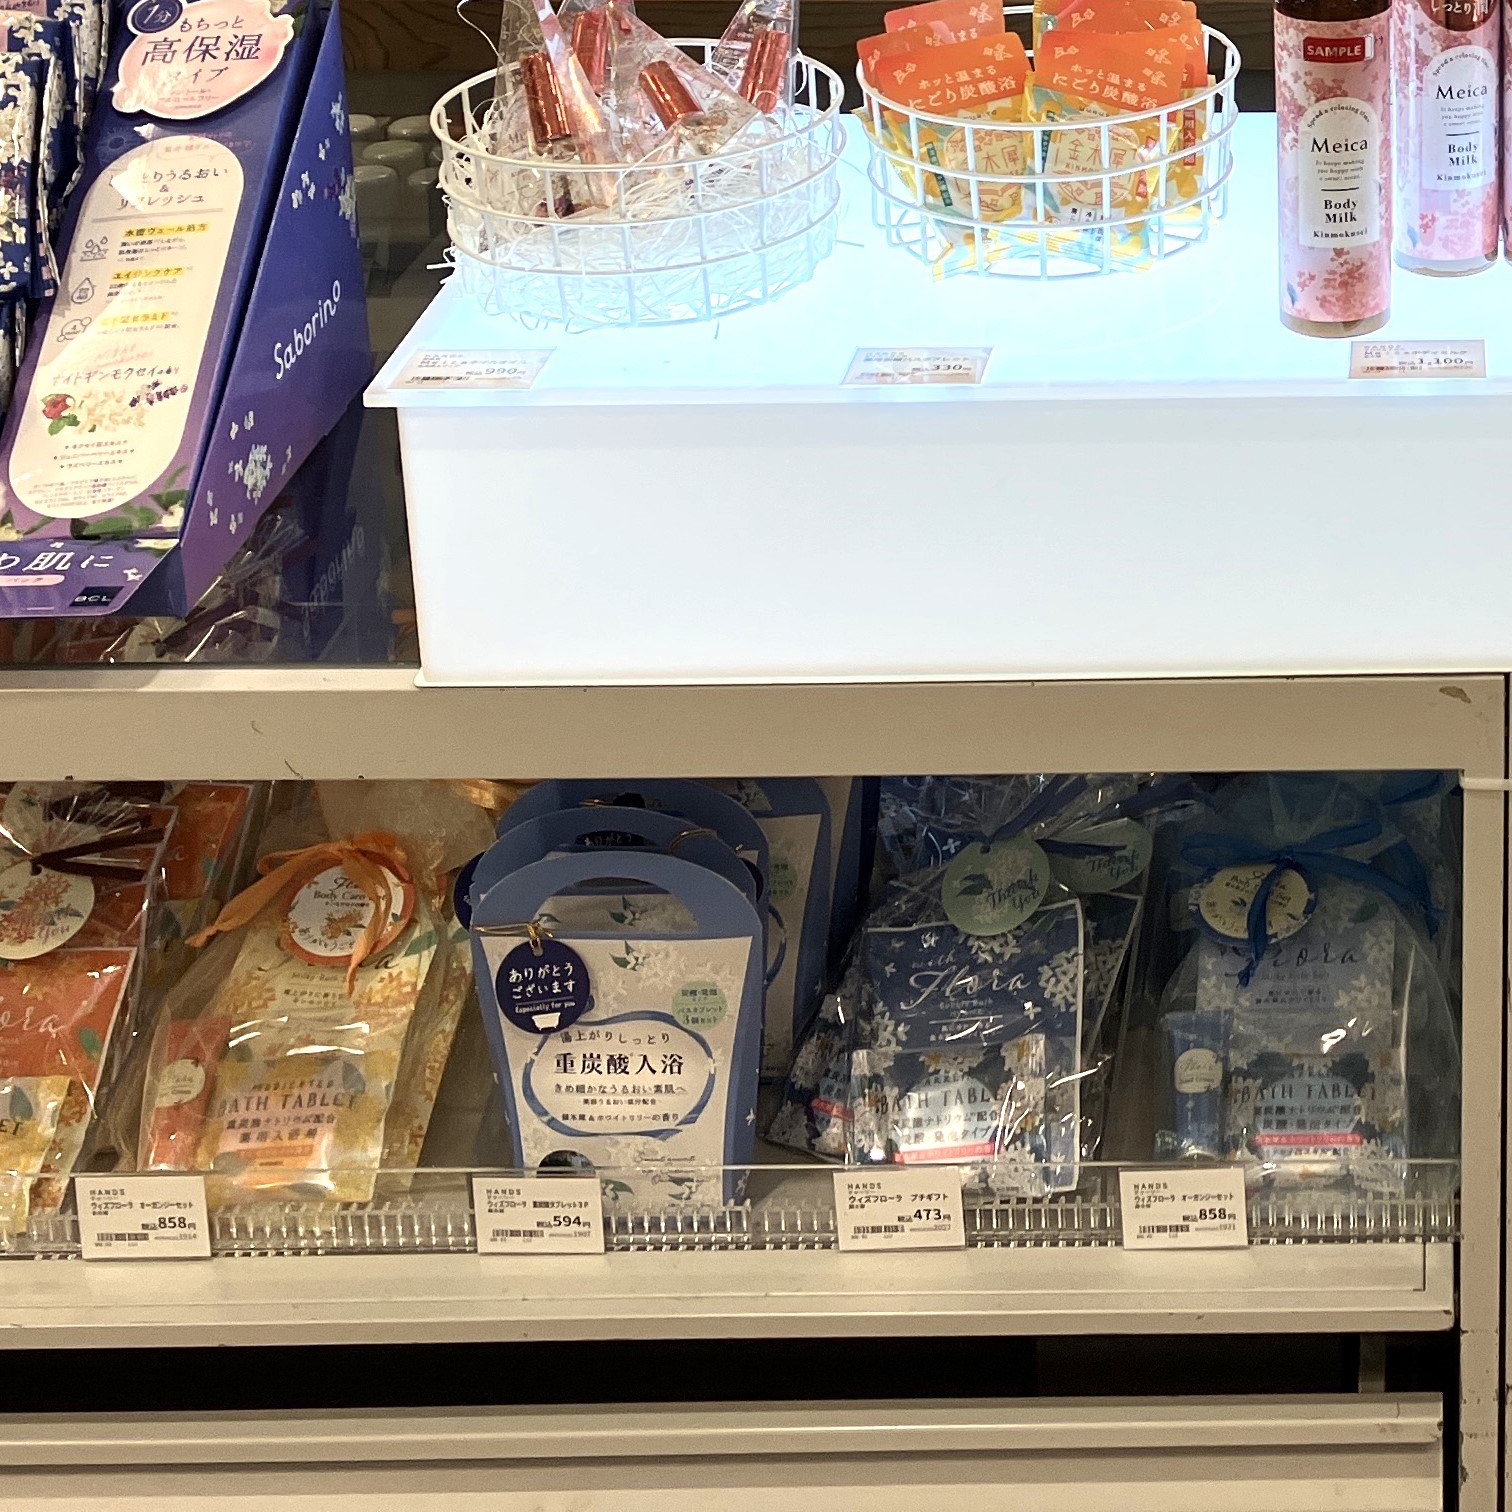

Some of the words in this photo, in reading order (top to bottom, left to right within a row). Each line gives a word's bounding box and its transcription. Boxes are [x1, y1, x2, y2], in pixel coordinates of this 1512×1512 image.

[143, 1, 172, 25] 1分
[180, 17, 244, 33] もちっと
[142, 34, 263, 64] 高保湿
[1306, 45, 1361, 56] SAMPLE
[918, 65, 997, 90] ホッと温まる
[1070, 63, 1147, 92] ホッと温まる
[908, 76, 1019, 111] にごり炭酸浴
[1052, 72, 1158, 109] にごり炭酸浴
[1435, 83, 1488, 100] Meica
[1310, 138, 1368, 154] Meica
[1448, 142, 1478, 155] Body
[1449, 155, 1478, 166] Milk
[1324, 199, 1358, 211] Body
[1325, 212, 1357, 224] Milk
[274, 279, 342, 382] Saborino
[509, 962, 574, 983] ありがとう
[512, 980, 576, 999] ございます
[515, 1002, 549, 1013] Especially
[561, 1031, 670, 1044] 湯上がりしっとり
[555, 1052, 685, 1075] 重炭酸入浴
[554, 1083, 688, 1095] きめ細かなうるおい素肌へ
[1133, 1182, 1168, 1190] HANDS
[848, 1193, 902, 1203] ウィズフローラ
[911, 1193, 949, 1201] プチギフト
[897, 1207, 951, 1222] 税込473円
[1183, 1207, 1236, 1221] 税込858円
[141, 1217, 196, 1230] 税込858円
[537, 1215, 591, 1229] 税込594円
